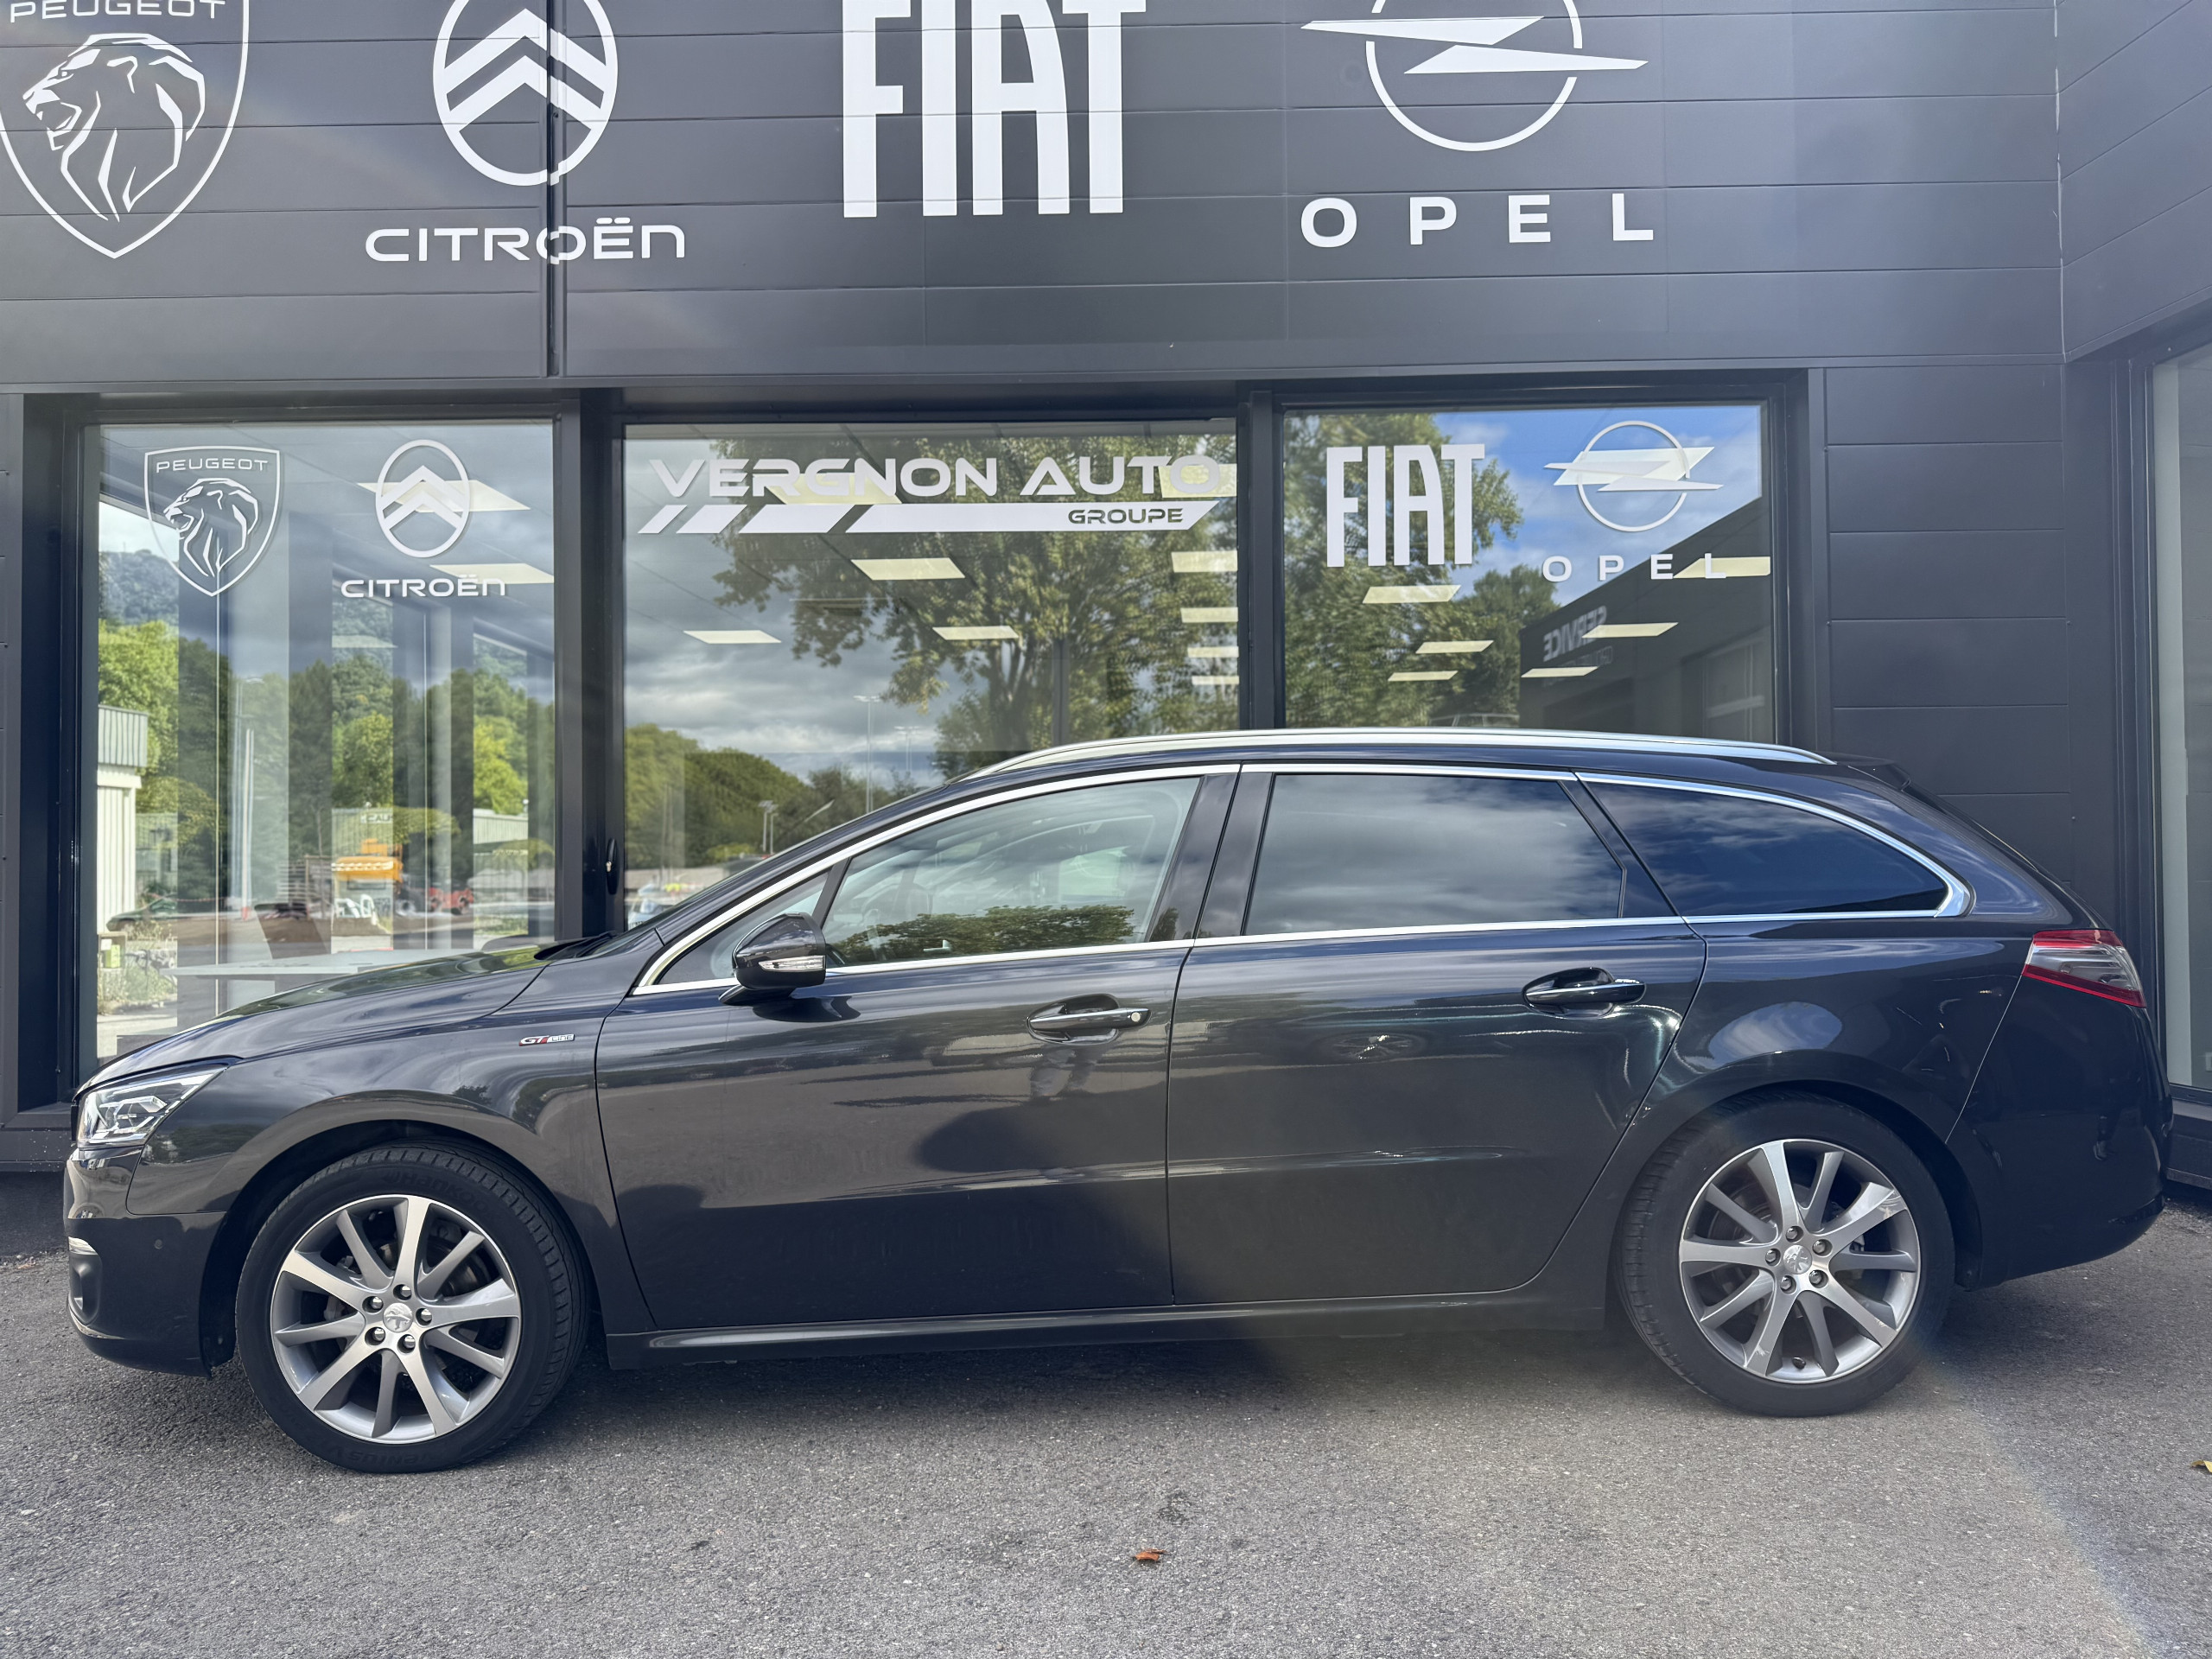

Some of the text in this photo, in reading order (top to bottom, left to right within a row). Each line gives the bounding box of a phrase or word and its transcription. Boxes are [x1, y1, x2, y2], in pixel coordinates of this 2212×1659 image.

[10, 0, 226, 23] PEUGEOT
[842, 0, 1147, 217] FIAT
[1300, 193, 1654, 248] OPEL
[365, 218, 685, 265] CITROËN
[156, 458, 269, 474] PEUGEOT
[650, 454, 1221, 498] VERGNON AUTO
[1068, 508, 1183, 524] GROUPE
[1326, 443, 1484, 568] FIAT
[1542, 553, 1727, 582] OPEL
[340, 575, 506, 598] CITROËN
